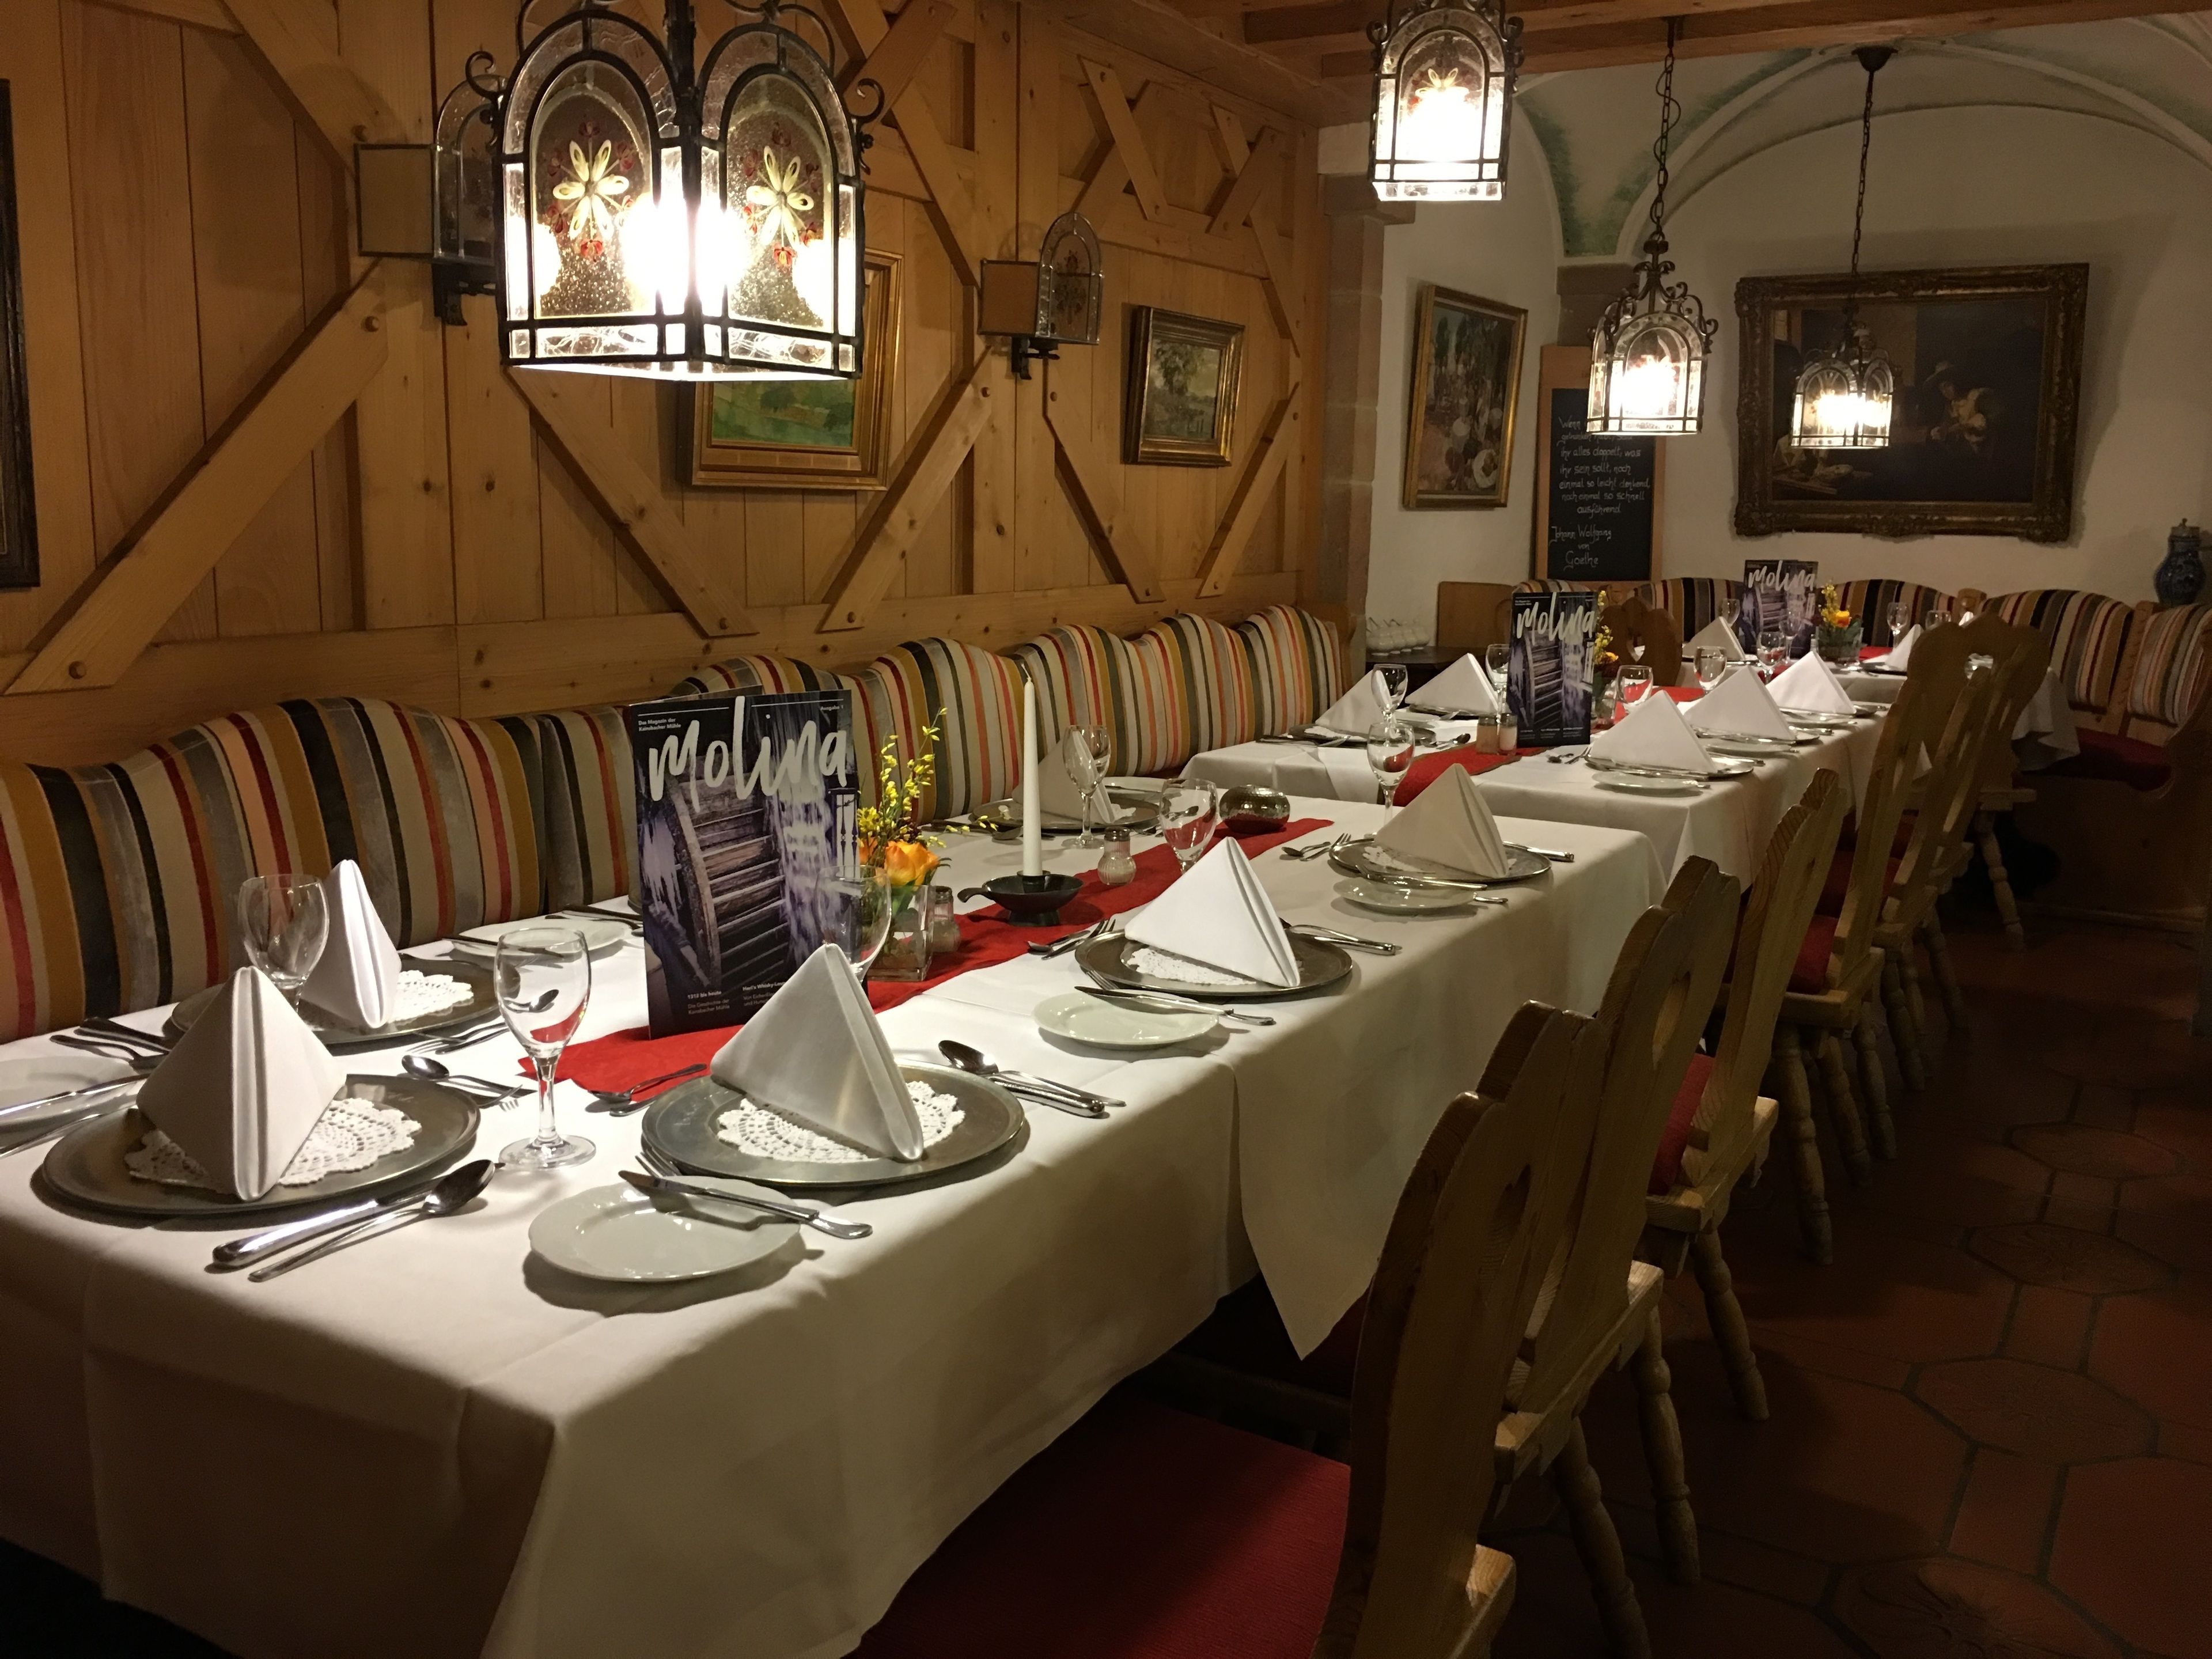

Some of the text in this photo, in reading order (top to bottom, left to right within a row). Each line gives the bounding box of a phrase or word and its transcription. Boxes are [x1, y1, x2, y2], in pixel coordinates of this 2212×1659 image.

[1558, 415, 1581, 430] Wenn
[1573, 445, 1590, 456] alles
[1574, 465, 1590, 476] sein
[1613, 464, 1631, 475] noch
[1559, 478, 1584, 489] einmal
[1616, 491, 1645, 503] schnell
[1577, 524, 1612, 544] Wolfgang
[1563, 551, 1599, 571] Goethe
